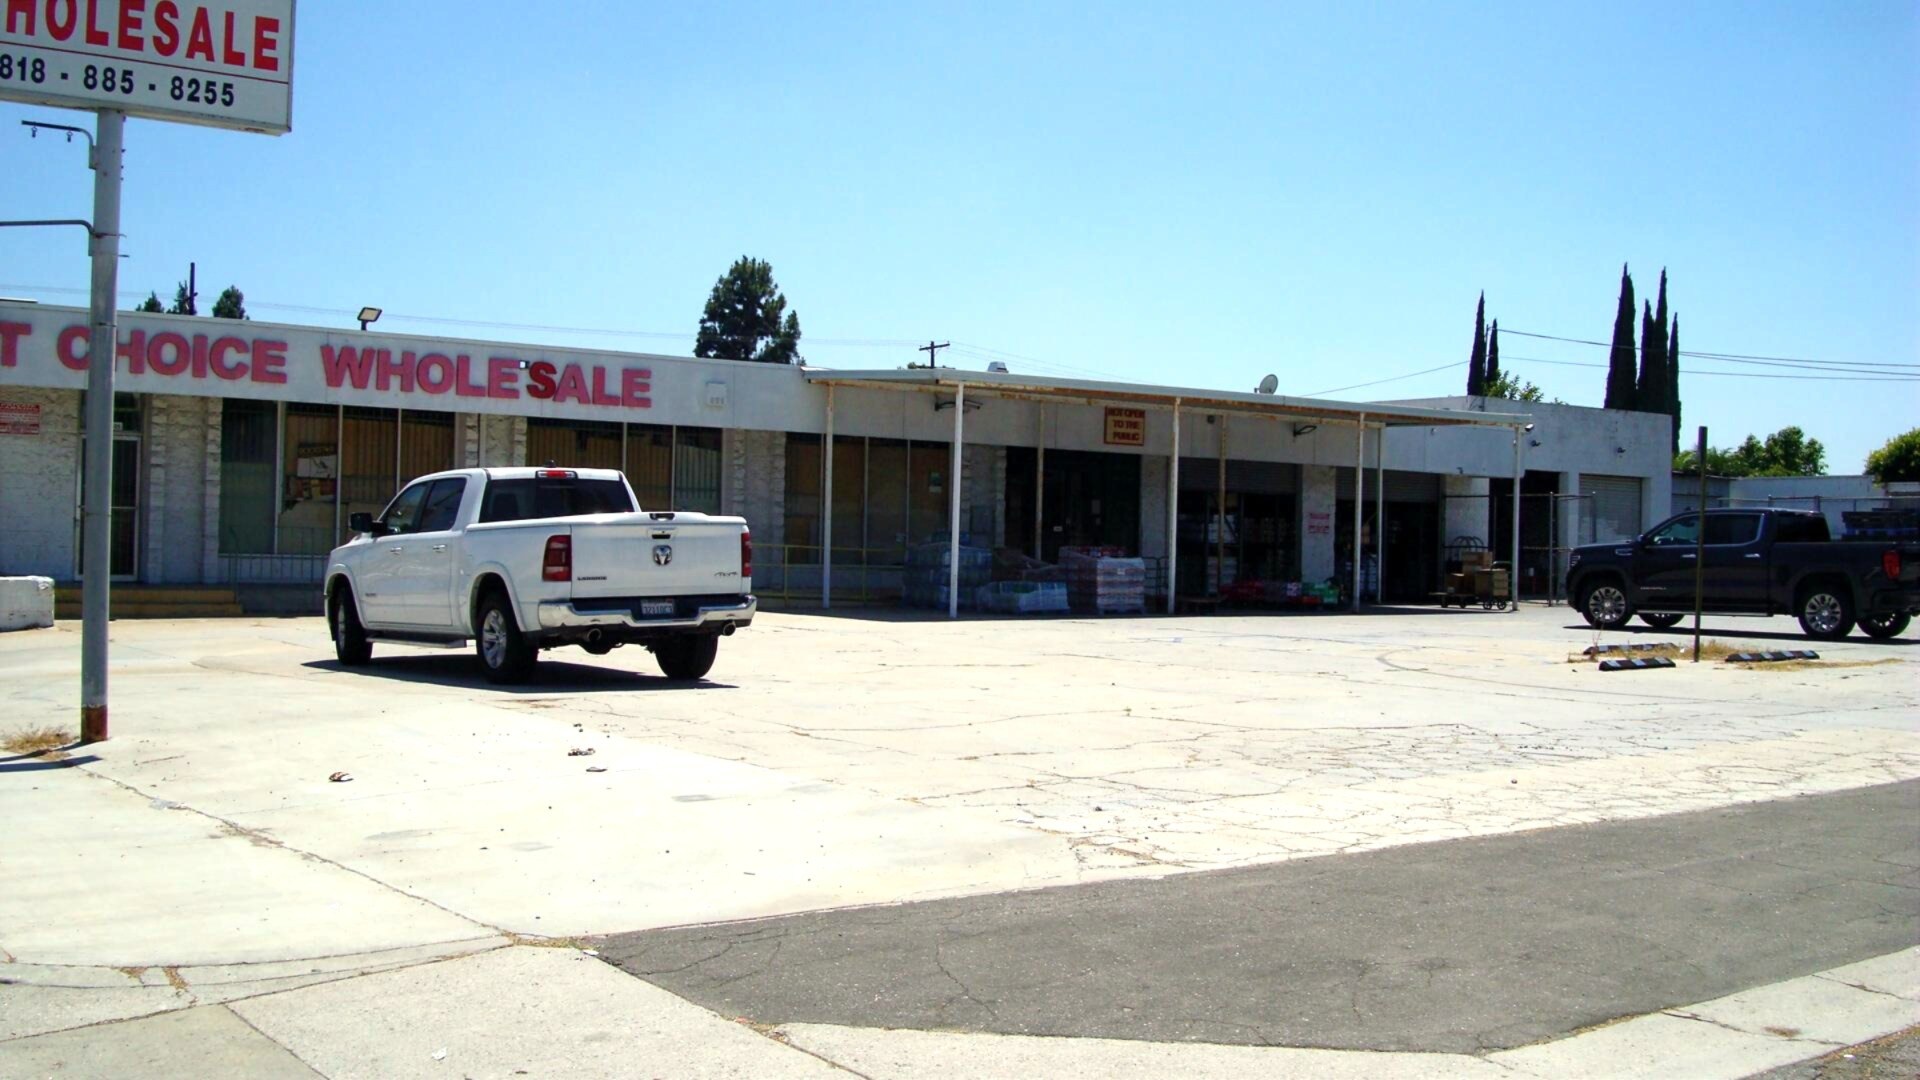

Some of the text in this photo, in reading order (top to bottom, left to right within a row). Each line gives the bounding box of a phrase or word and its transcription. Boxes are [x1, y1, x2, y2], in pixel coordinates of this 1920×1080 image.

[0, 54, 45, 83] 818
[83, 64, 134, 94] 885
[170, 76, 235, 106] 8255
[57, 325, 288, 384] CHOICE
[320, 345, 651, 408] WHOLESALE
[1113, 420, 1139, 429] TO THE
